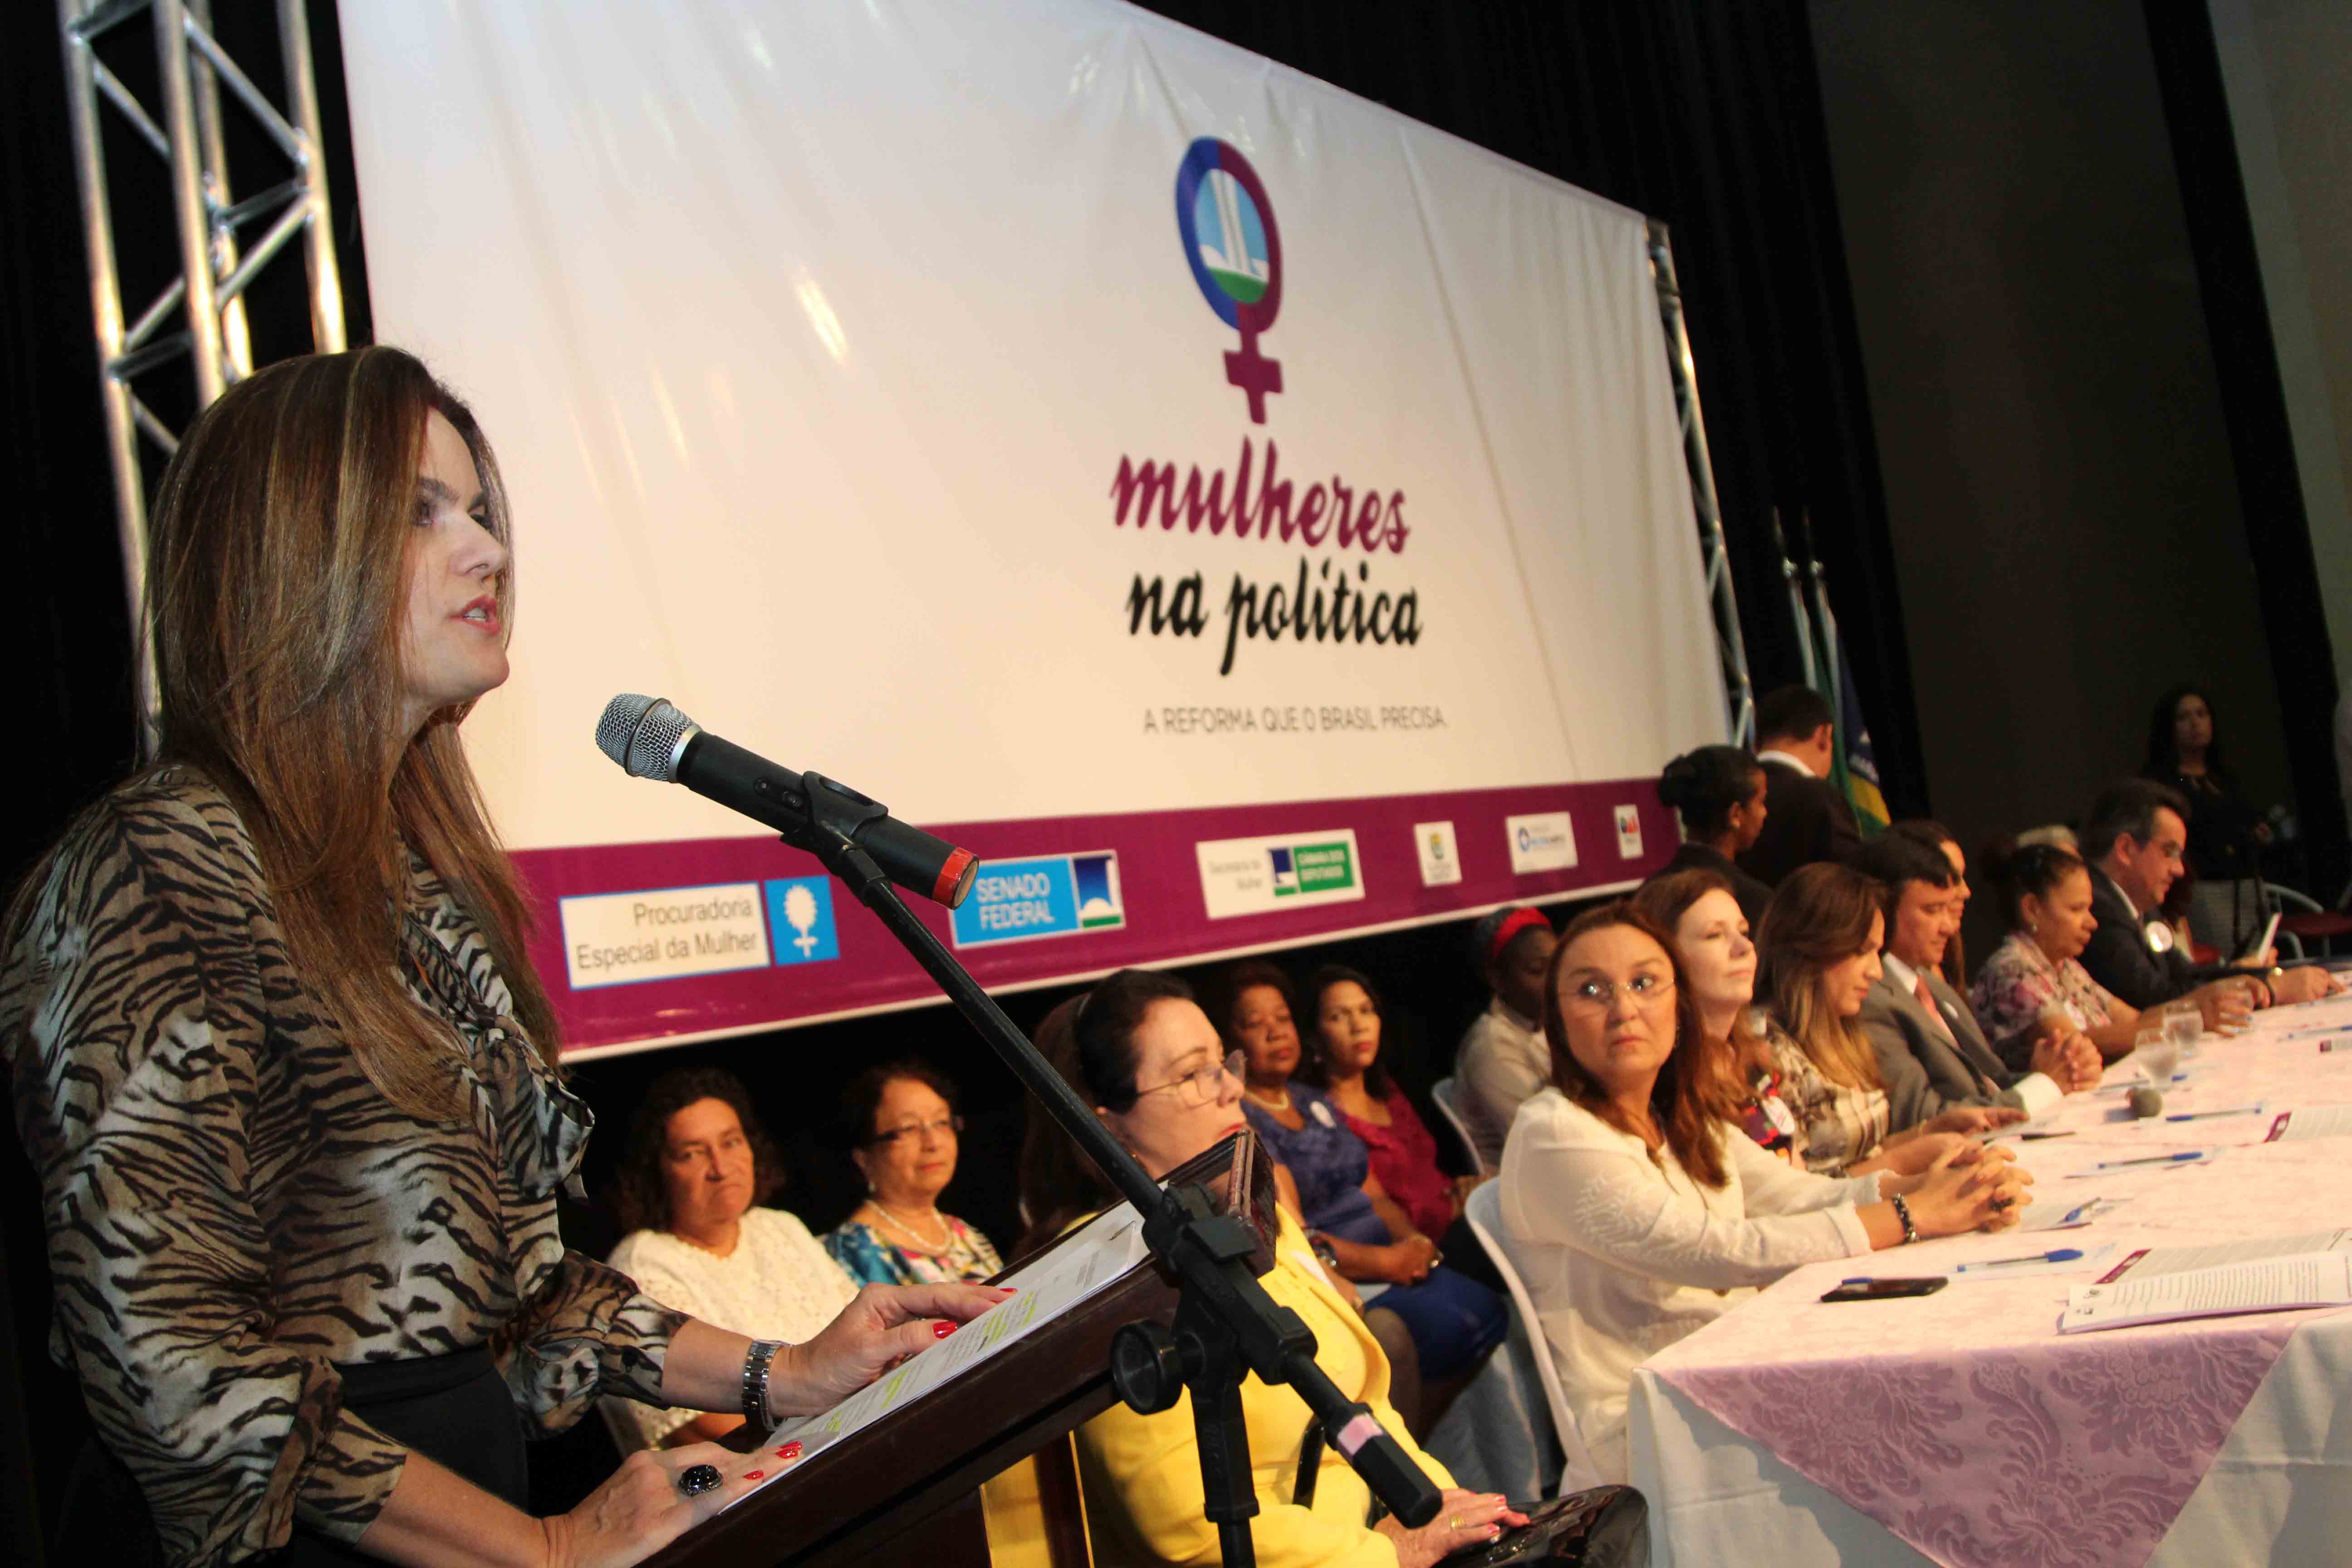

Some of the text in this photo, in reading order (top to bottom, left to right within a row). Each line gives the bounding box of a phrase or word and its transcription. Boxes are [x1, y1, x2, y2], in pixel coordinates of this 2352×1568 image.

[1110, 434, 1410, 554] mulheres
[1125, 554, 1423, 676] na política
[1144, 705, 1448, 735] A REFORMA QUE O BRASIL PRECISA
[975, 872, 1051, 903] SENADO
[632, 896, 753, 926] Procuradoria
[979, 900, 1055, 930] FEDERAL
[575, 929, 757, 973] Especial da Mulher
